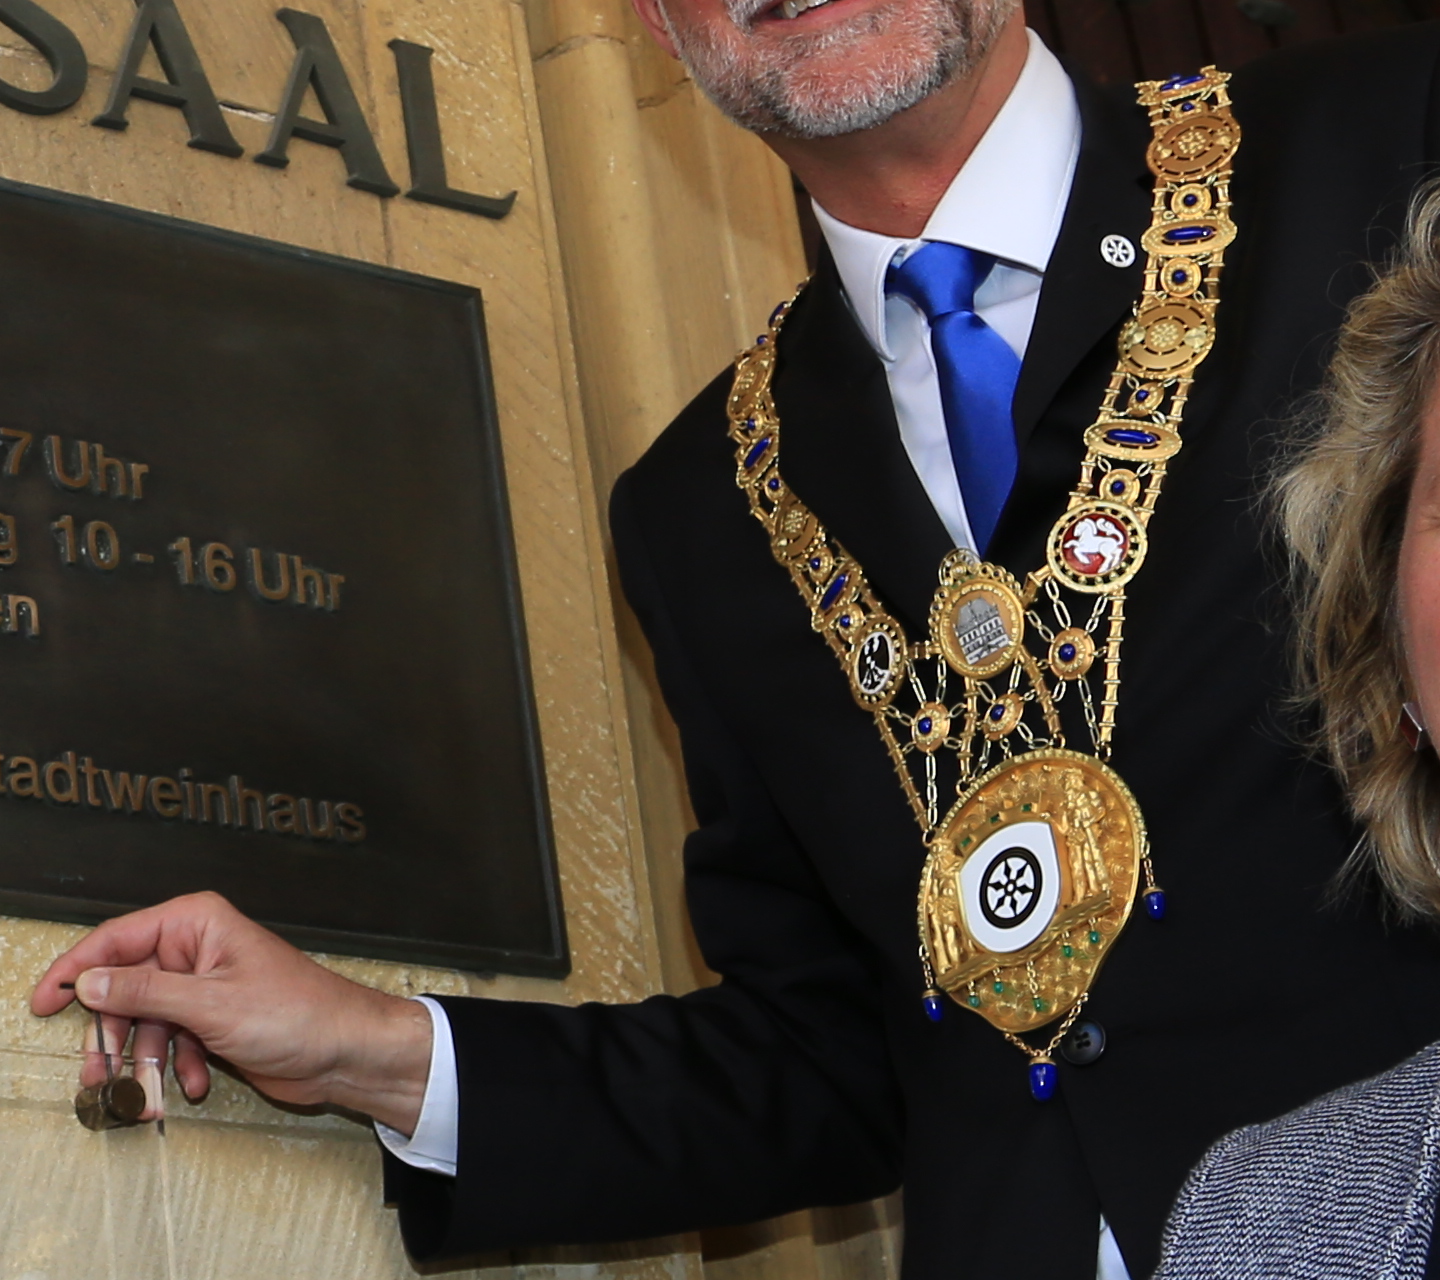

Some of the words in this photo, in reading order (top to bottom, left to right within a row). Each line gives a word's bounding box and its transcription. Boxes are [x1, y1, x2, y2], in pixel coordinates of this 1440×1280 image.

[45, 434, 149, 500] Uhr
[51, 515, 120, 571] 10
[169, 536, 238, 591] 16
[246, 547, 346, 611] Uhr
